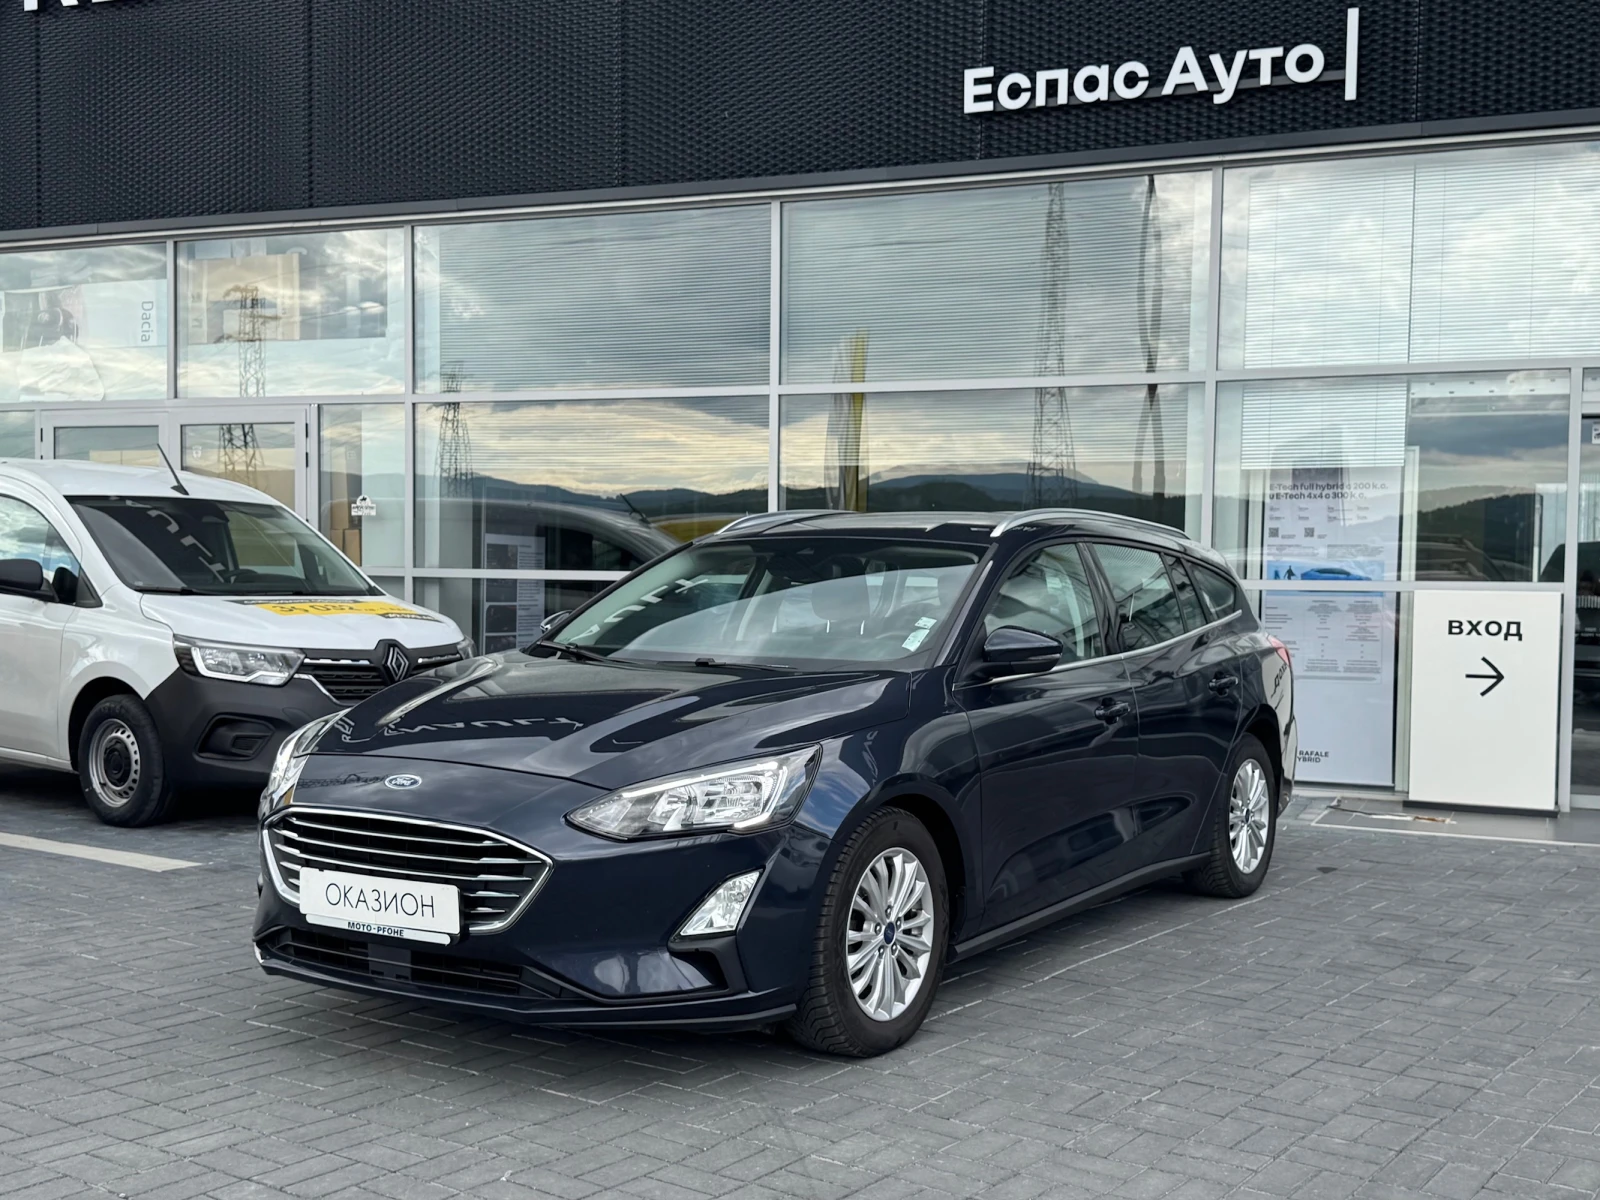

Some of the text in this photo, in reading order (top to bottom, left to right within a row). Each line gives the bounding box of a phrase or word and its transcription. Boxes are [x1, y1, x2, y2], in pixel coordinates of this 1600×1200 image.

[963, 43, 1325, 114] Еспас Ауто
[140, 300, 154, 343] Dacia
[1275, 492, 1305, 500] E-Tech
[1306, 491, 1323, 500] 4x4
[1331, 491, 1348, 500] 300
[1300, 482, 1314, 491] full
[1315, 482, 1344, 492] hybrid
[1354, 482, 1370, 490] 200
[1299, 750, 1329, 758] RAFALE
[325, 882, 435, 918] ОКАЗИОН
